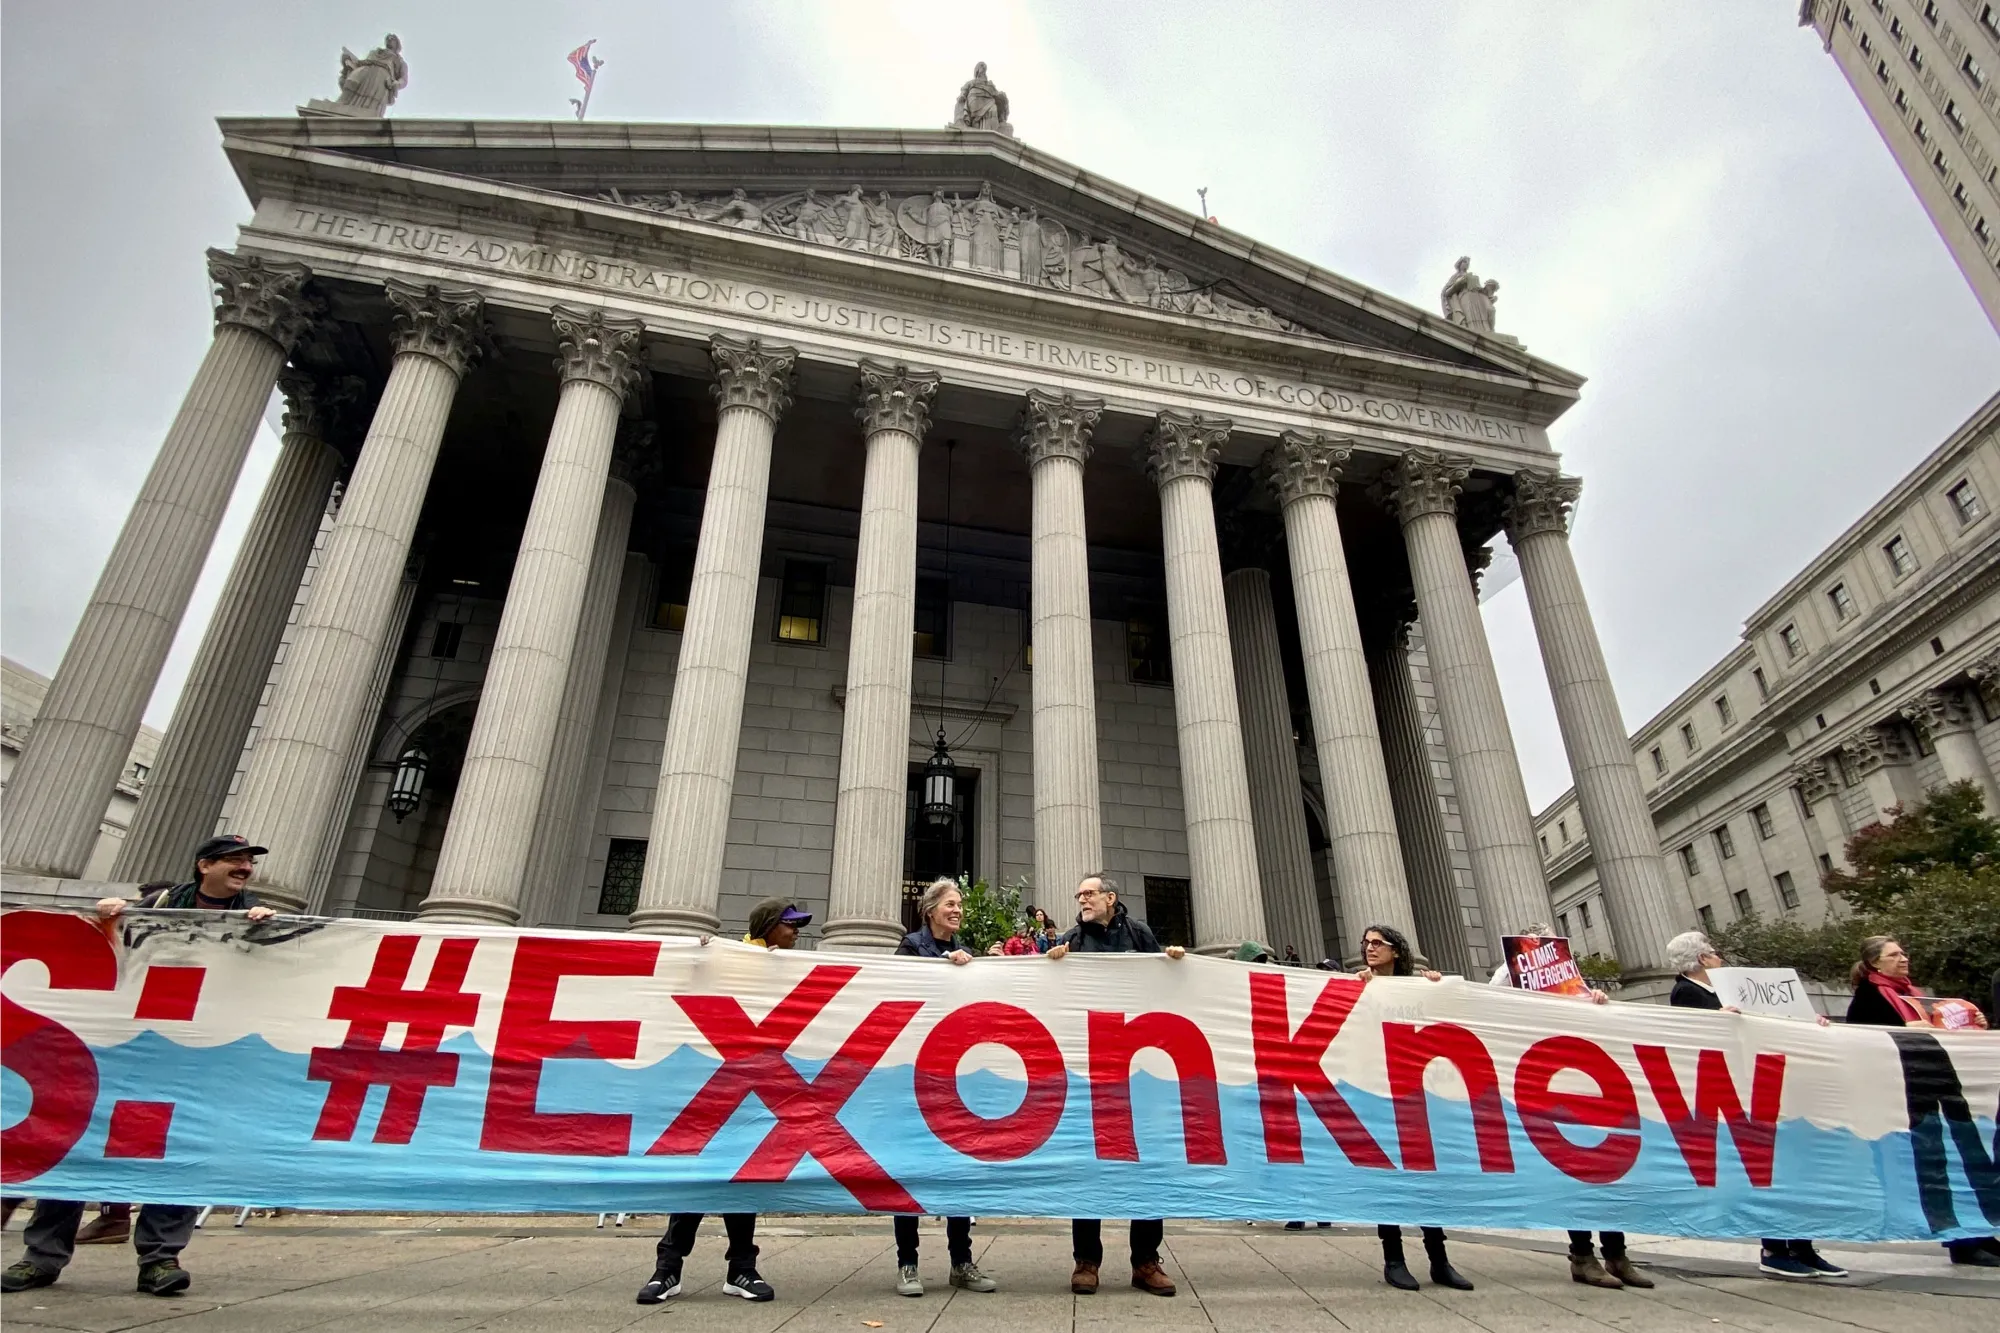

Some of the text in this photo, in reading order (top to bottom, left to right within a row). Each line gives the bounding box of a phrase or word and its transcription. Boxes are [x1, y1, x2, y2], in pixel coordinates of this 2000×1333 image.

[294, 208, 1529, 445] THE TRUE ADMINISTRATION OF JUSTICE IS THE FIRMEST PILLAR OF GOOD GOVERNMENT
[1517, 941, 1560, 973] CLIMATE
[1519, 959, 1577, 991] EMERGENCY
[1738, 977, 1796, 1006] #DIVEST
